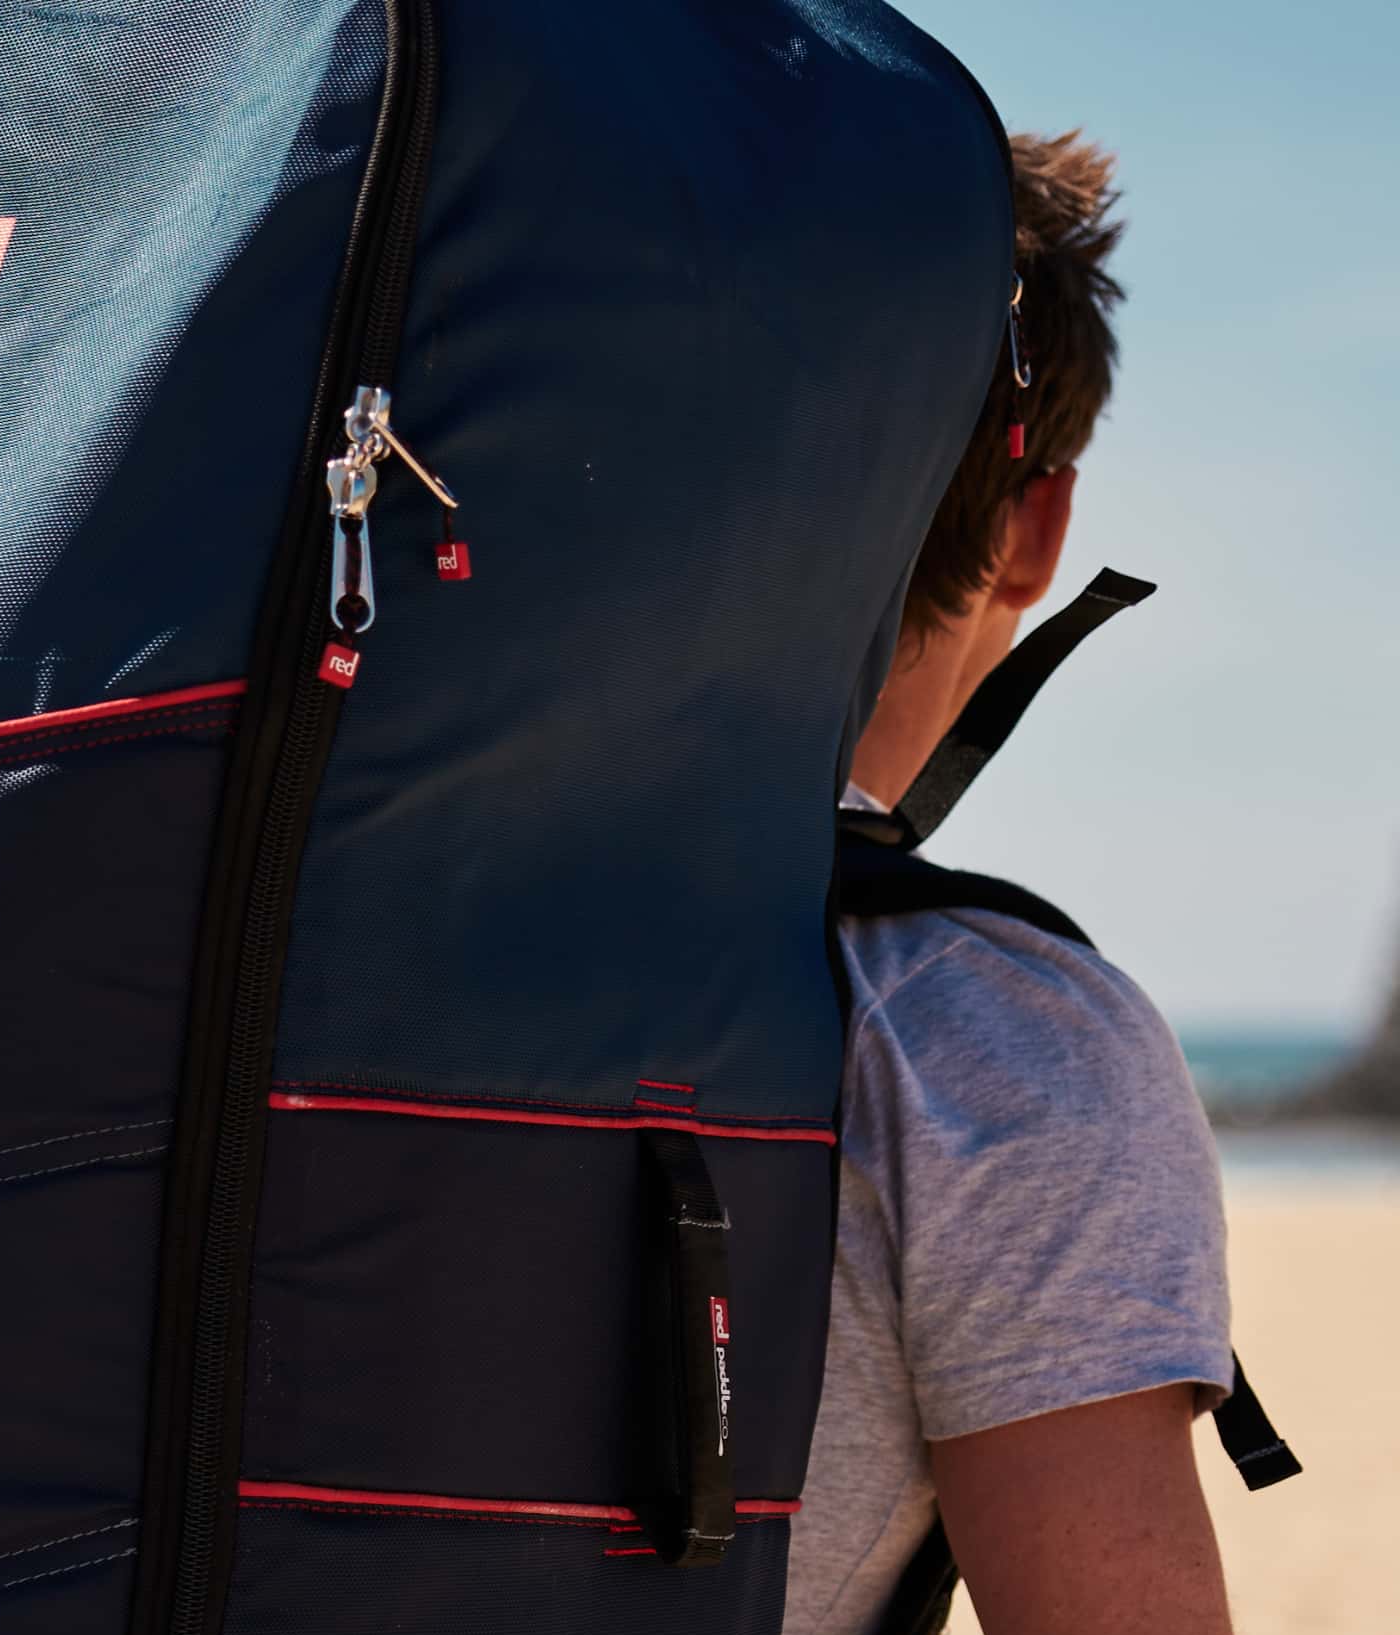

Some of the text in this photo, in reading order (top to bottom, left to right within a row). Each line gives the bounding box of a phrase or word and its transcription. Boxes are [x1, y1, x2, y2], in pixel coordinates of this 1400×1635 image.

[437, 544, 458, 571] red
[328, 651, 360, 677] red
[714, 1304, 730, 1340] red
[716, 1346, 732, 1415] paddle
